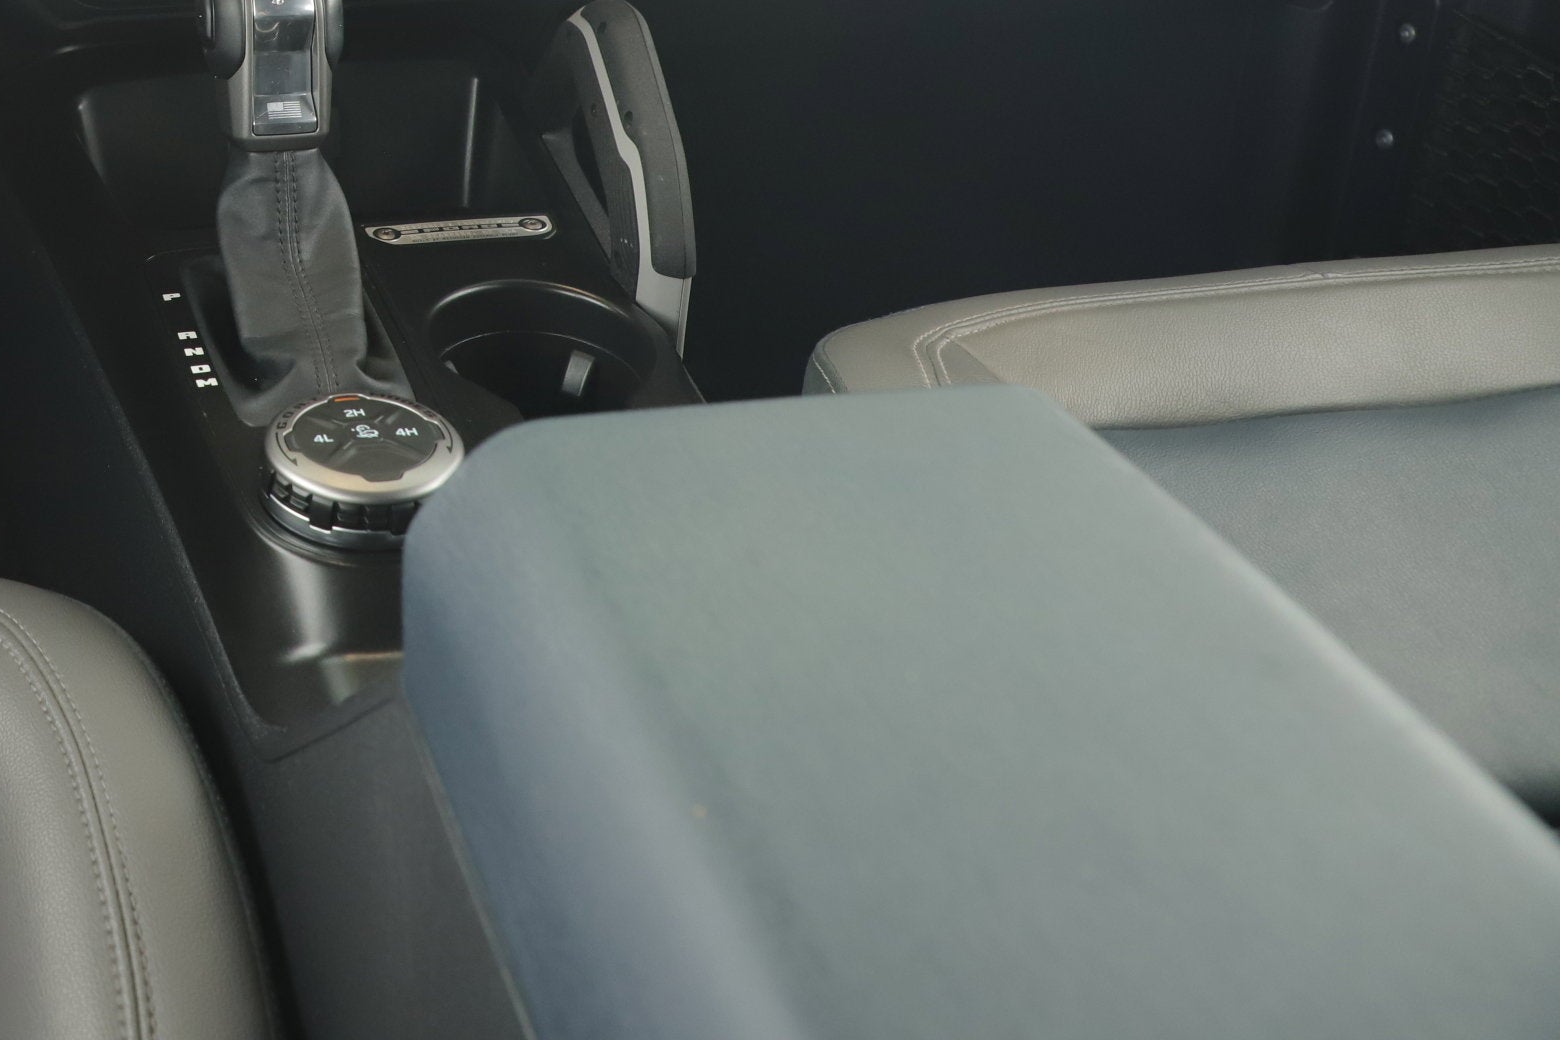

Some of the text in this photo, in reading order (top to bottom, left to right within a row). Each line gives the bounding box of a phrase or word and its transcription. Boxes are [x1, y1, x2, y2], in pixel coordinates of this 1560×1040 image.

[162, 293, 181, 301] P
[184, 347, 204, 357] N
[190, 364, 211, 374] D
[195, 378, 218, 388] M
[344, 409, 365, 418] 2H
[395, 427, 419, 437] 4H
[313, 434, 334, 444] 4L
